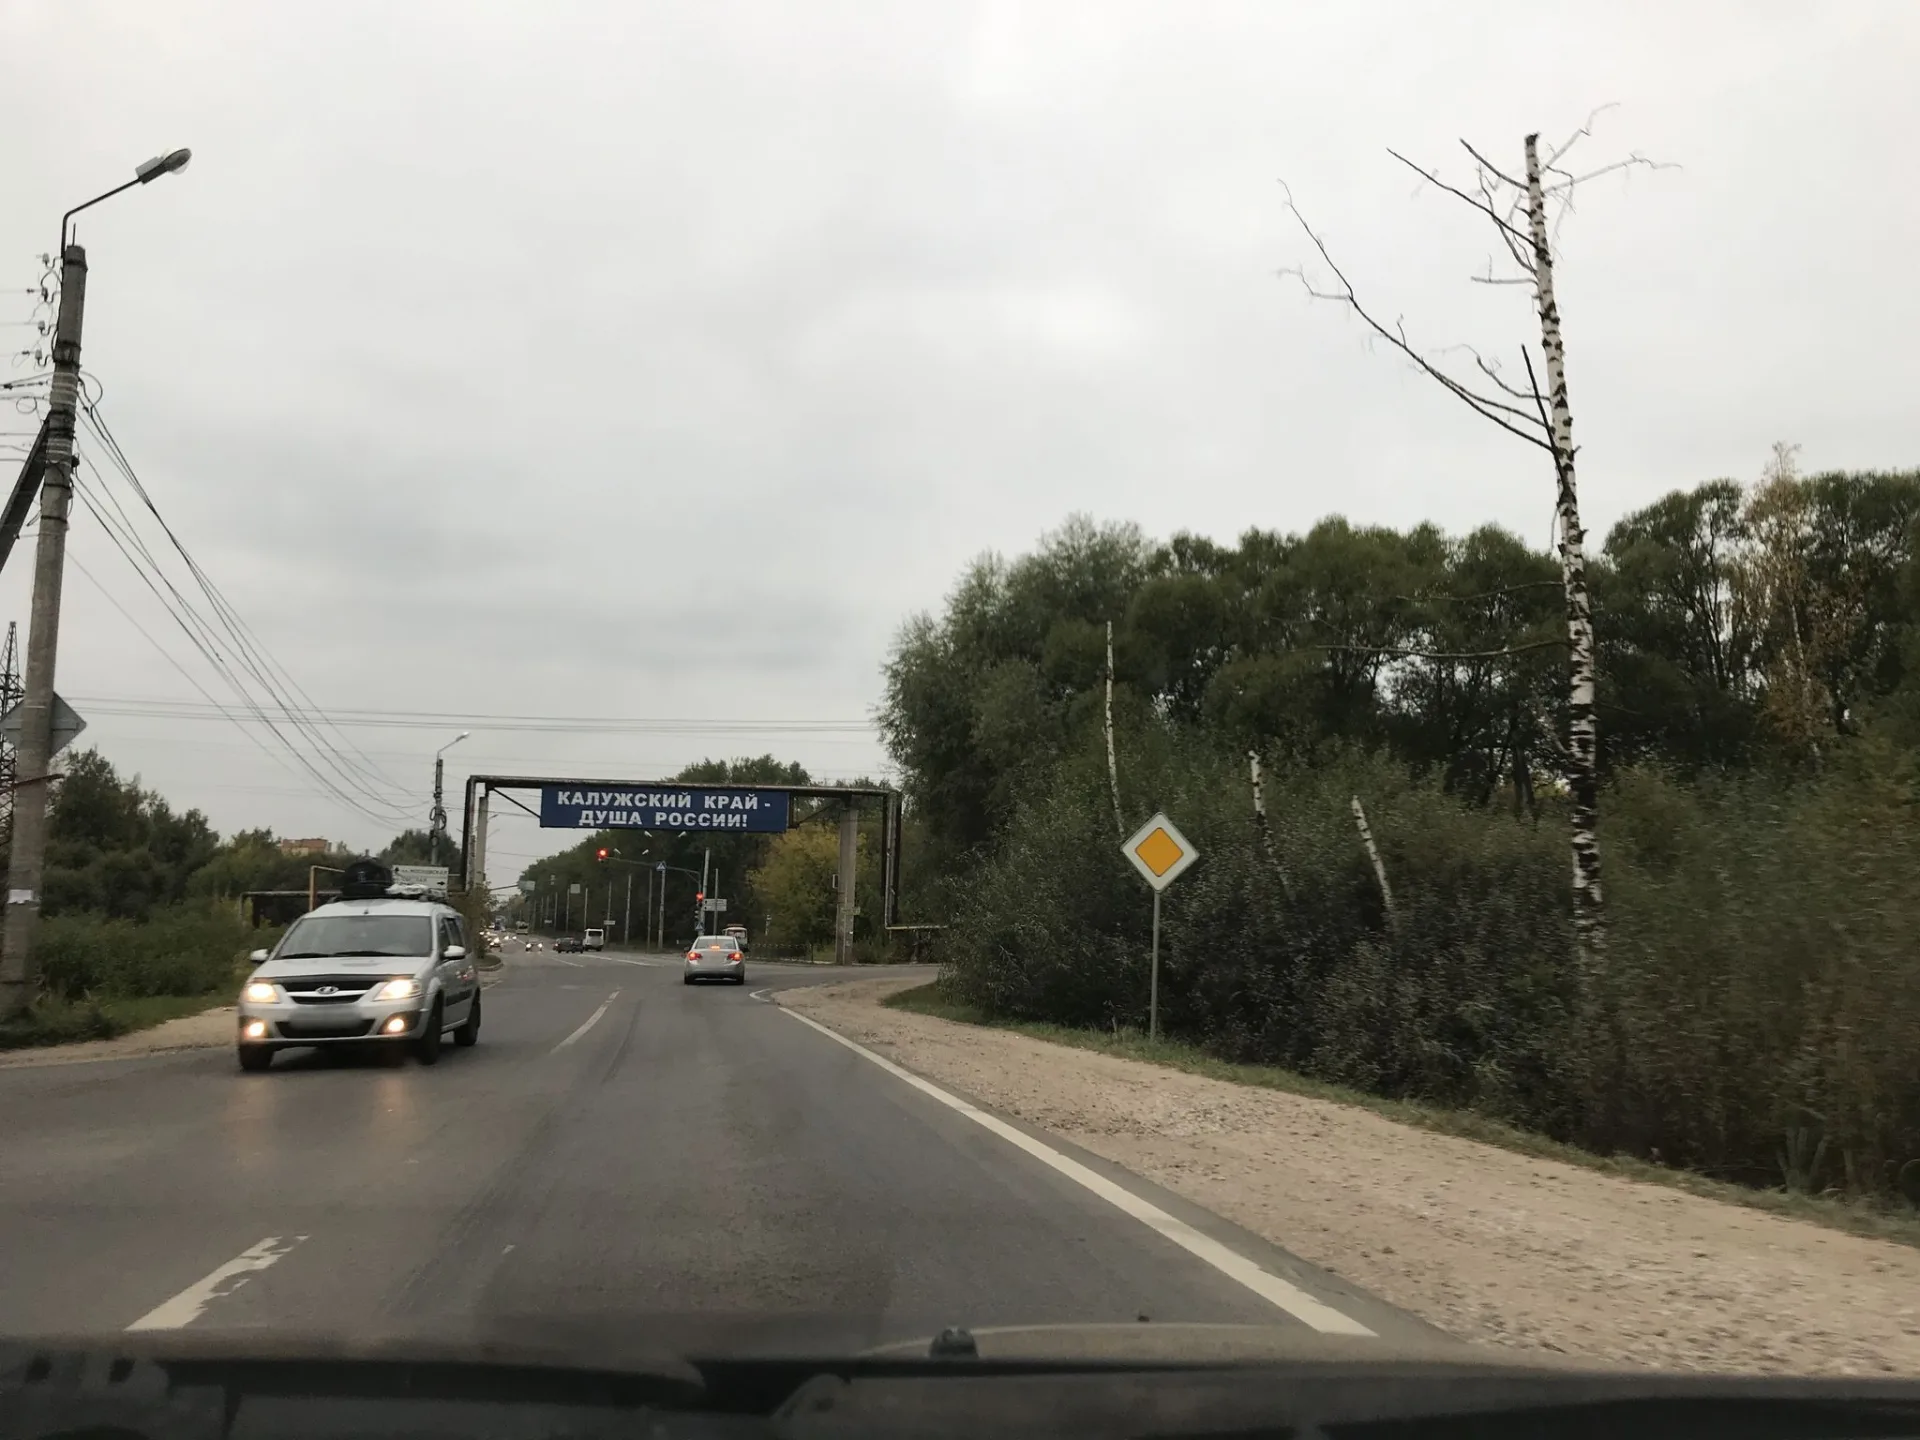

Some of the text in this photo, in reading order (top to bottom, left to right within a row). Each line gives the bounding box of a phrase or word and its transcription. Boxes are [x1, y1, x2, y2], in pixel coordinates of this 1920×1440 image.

[557, 790, 691, 809] КАЛУЖСКИЙ
[704, 793, 758, 810] КРАЙ
[578, 810, 748, 828] ДУША РОССИИ!
